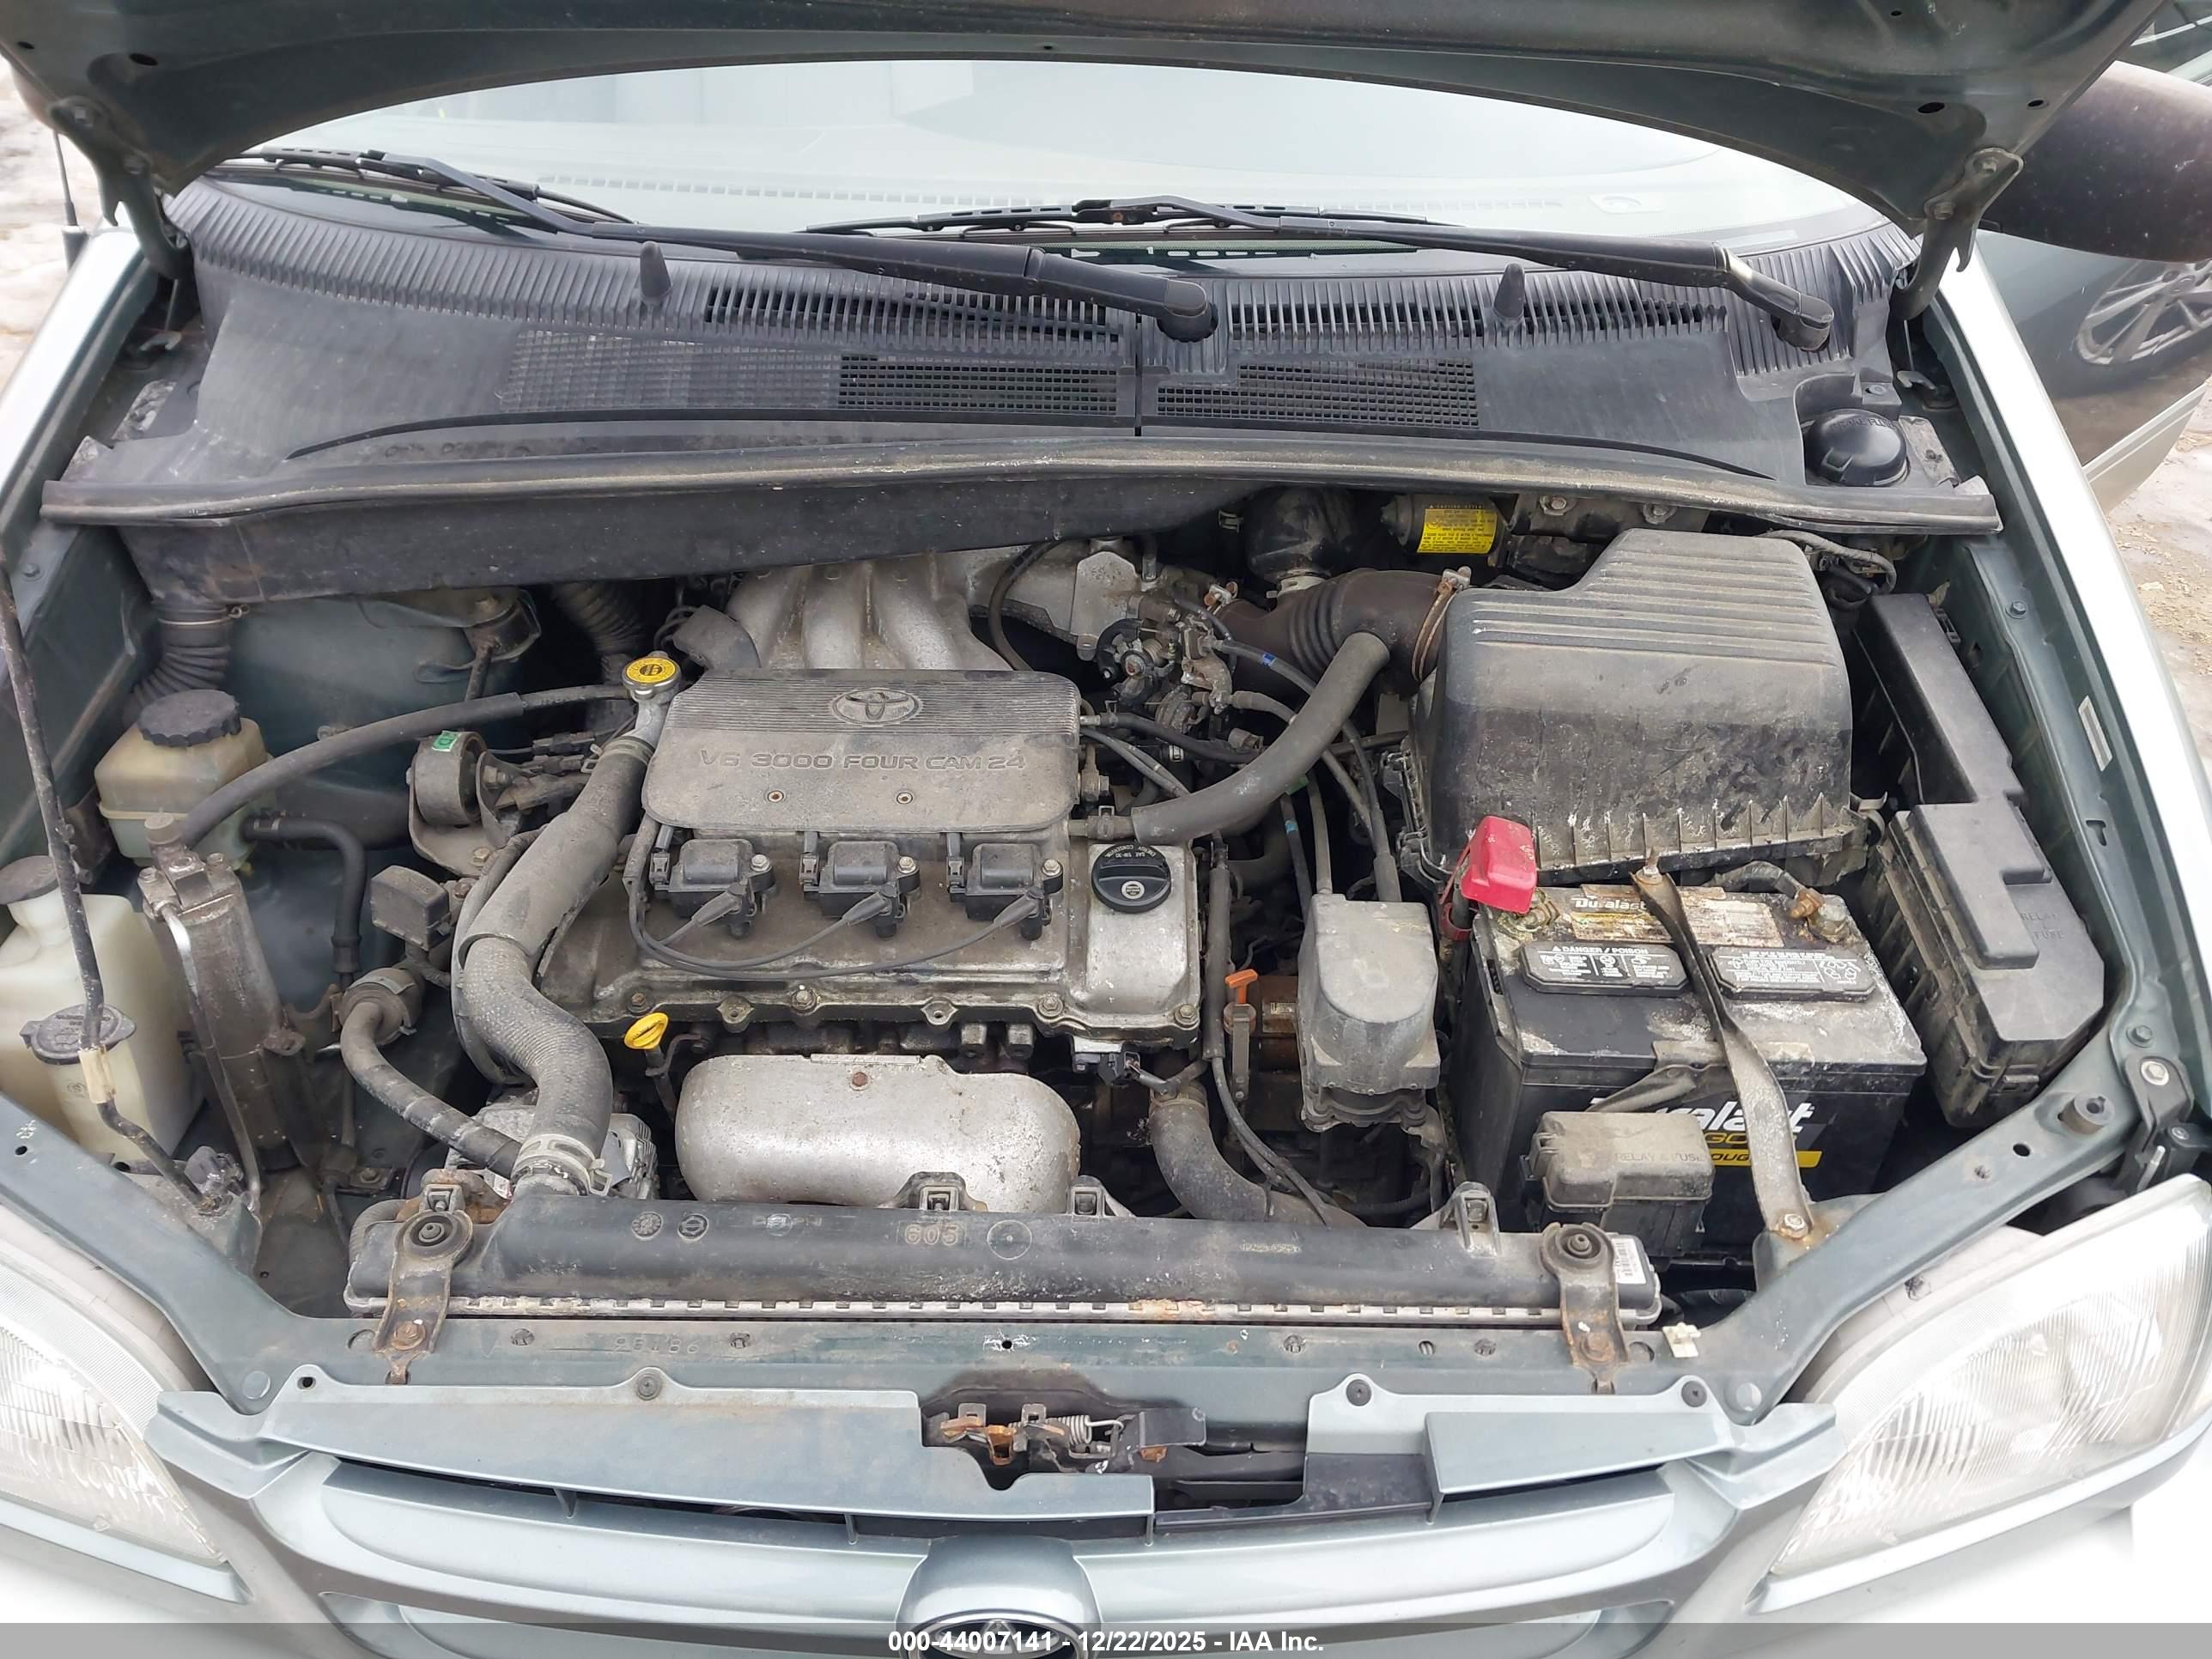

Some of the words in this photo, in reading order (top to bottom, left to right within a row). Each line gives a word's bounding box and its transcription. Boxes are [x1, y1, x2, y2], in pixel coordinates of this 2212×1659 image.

[700, 750, 740, 766] V6
[750, 751, 833, 769] 3000
[842, 754, 919, 771] FOUR
[926, 754, 982, 771] CAM
[987, 750, 1025, 770] 24
[1571, 896, 1648, 910] Dualast
